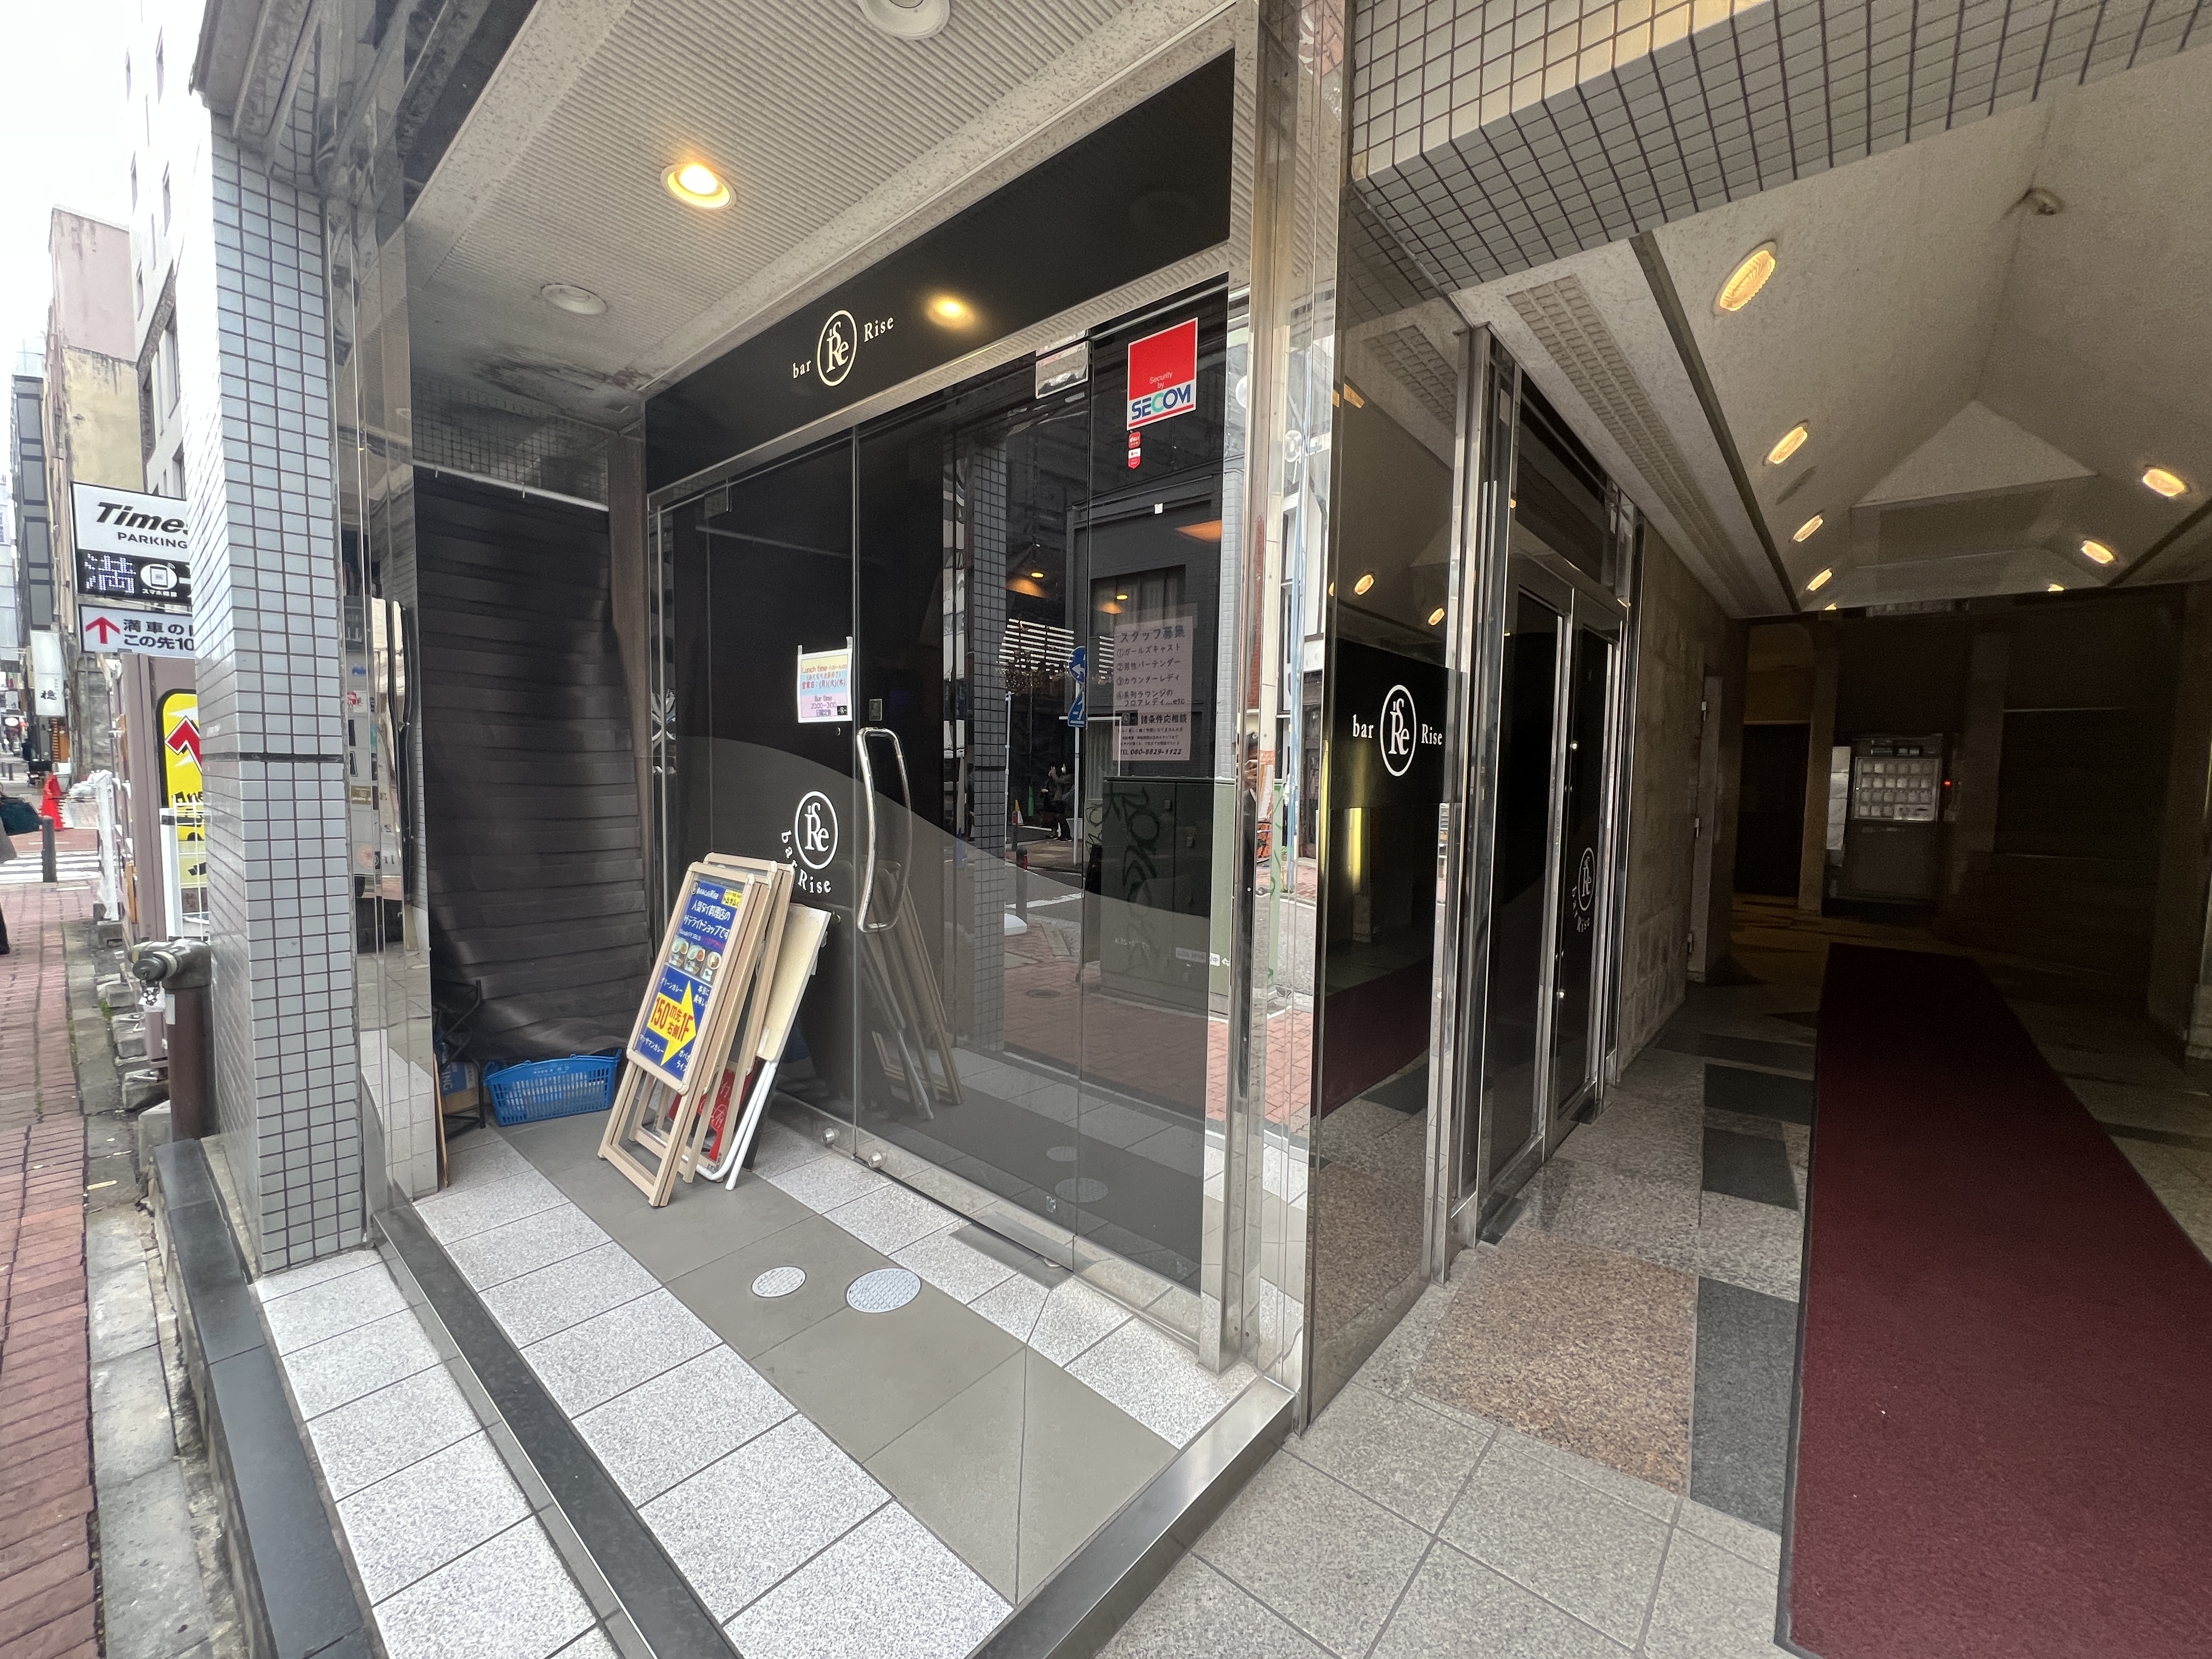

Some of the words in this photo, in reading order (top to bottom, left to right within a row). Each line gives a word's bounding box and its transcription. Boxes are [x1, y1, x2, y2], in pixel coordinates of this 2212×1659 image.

[792, 360, 811, 379] bar
[864, 317, 894, 343] Rise
[1149, 370, 1173, 385] Security
[1157, 381, 1165, 390] by
[1131, 383, 1192, 421] SECOM
[96, 501, 188, 535] Time
[117, 532, 188, 549] PARKING
[123, 618, 193, 637] 満車の
[1120, 624, 1185, 643] スタッフ募集
[1352, 714, 1374, 738] bar
[1421, 724, 1443, 746] Rise
[781, 829, 798, 867] bar
[798, 868, 832, 894] Rise
[697, 985, 710, 996] 本当に
